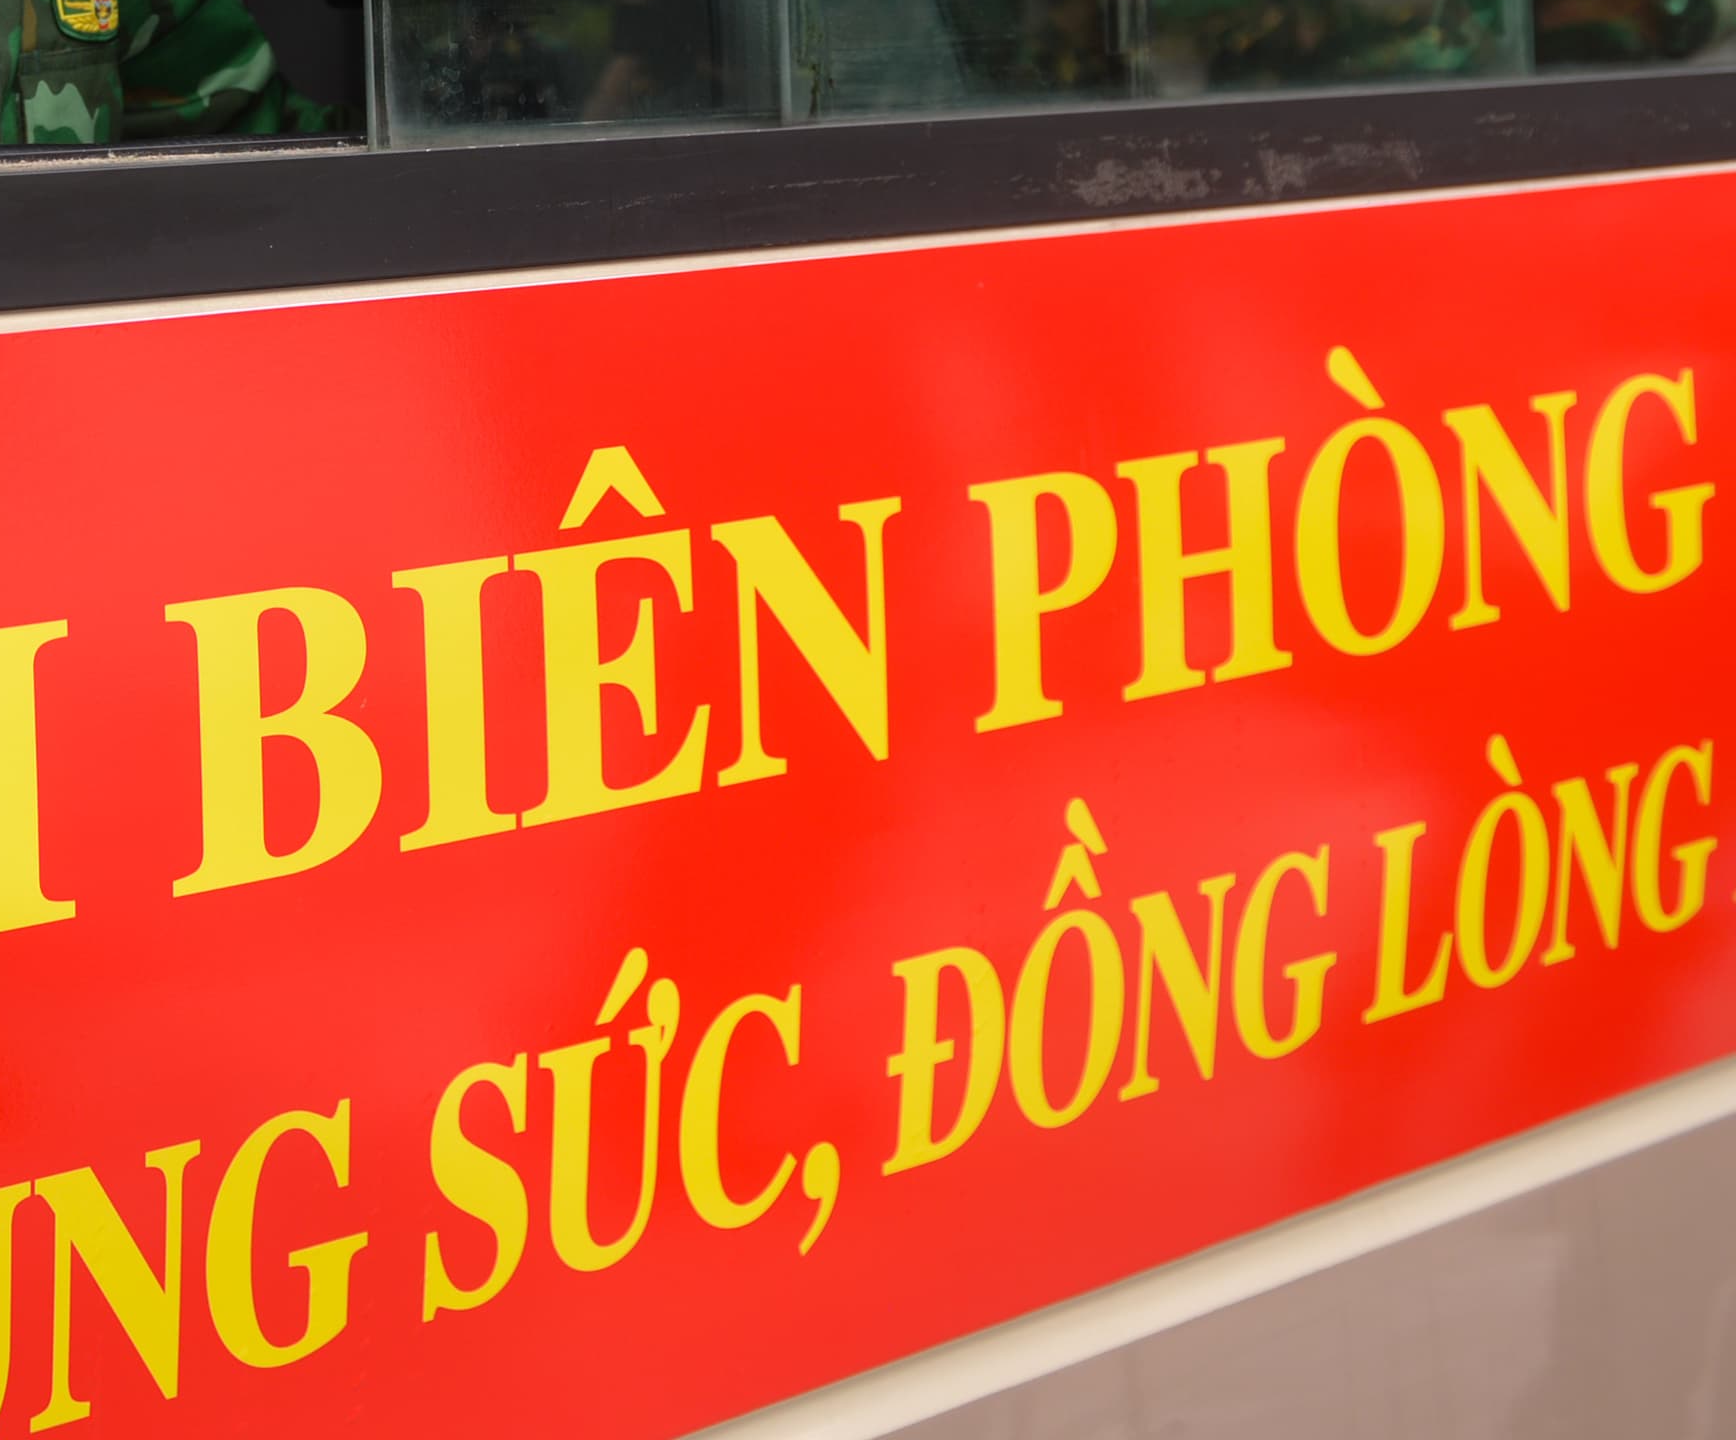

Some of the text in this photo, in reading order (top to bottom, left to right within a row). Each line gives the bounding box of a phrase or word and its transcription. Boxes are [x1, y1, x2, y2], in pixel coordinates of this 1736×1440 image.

[164, 446, 902, 898] BIÊN
[968, 346, 1715, 733] PHÒNG
[422, 947, 841, 1322] SỨC,
[882, 797, 1337, 1176] ĐỒNG
[1363, 734, 1717, 1024] LÒNG
